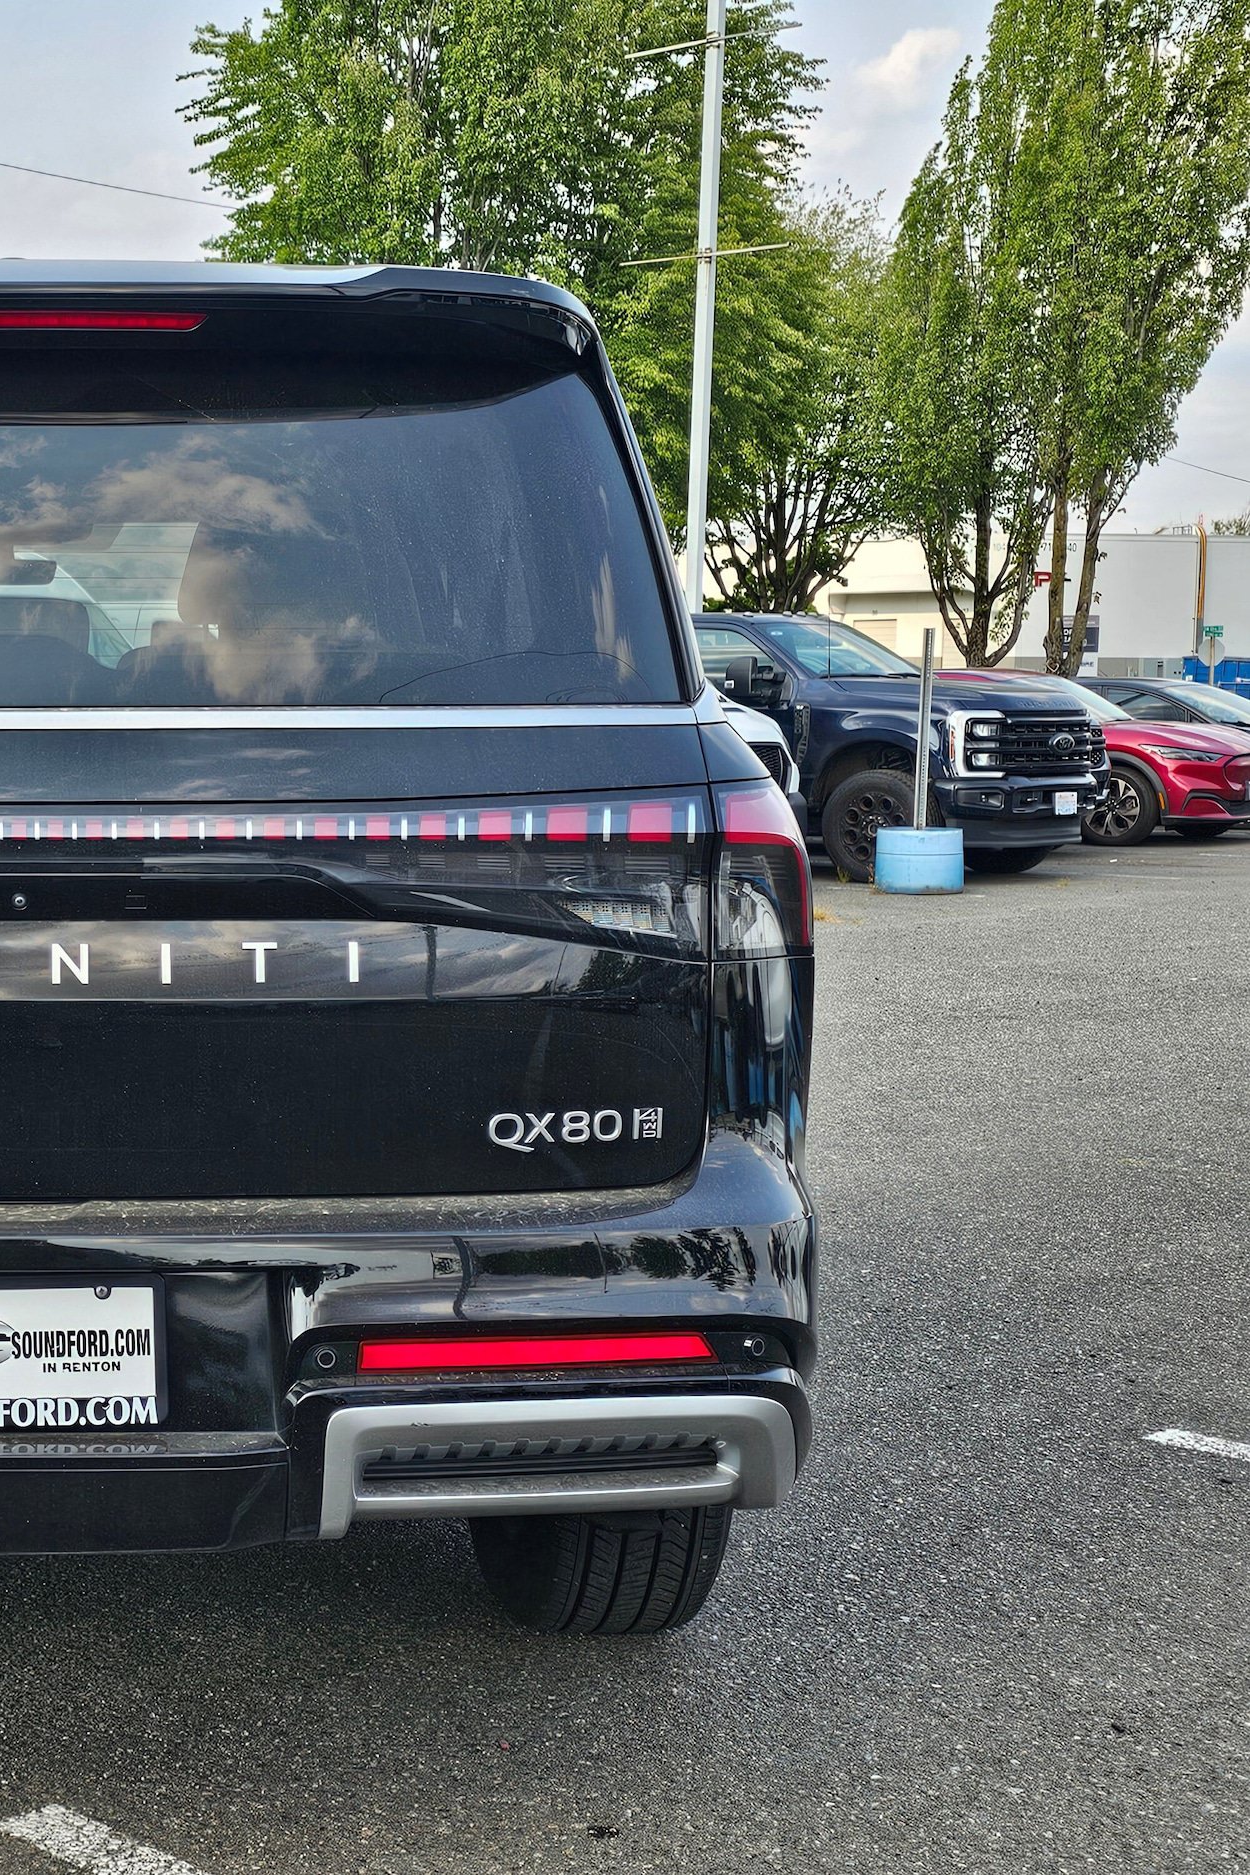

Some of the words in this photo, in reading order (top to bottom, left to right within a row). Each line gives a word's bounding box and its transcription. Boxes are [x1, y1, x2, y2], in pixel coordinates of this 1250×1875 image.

[488, 1109, 623, 1153] QX80
[11, 1328, 151, 1359] SOUNDFORD.COM
[42, 1362, 57, 1373] IN
[62, 1361, 121, 1373] RENTON
